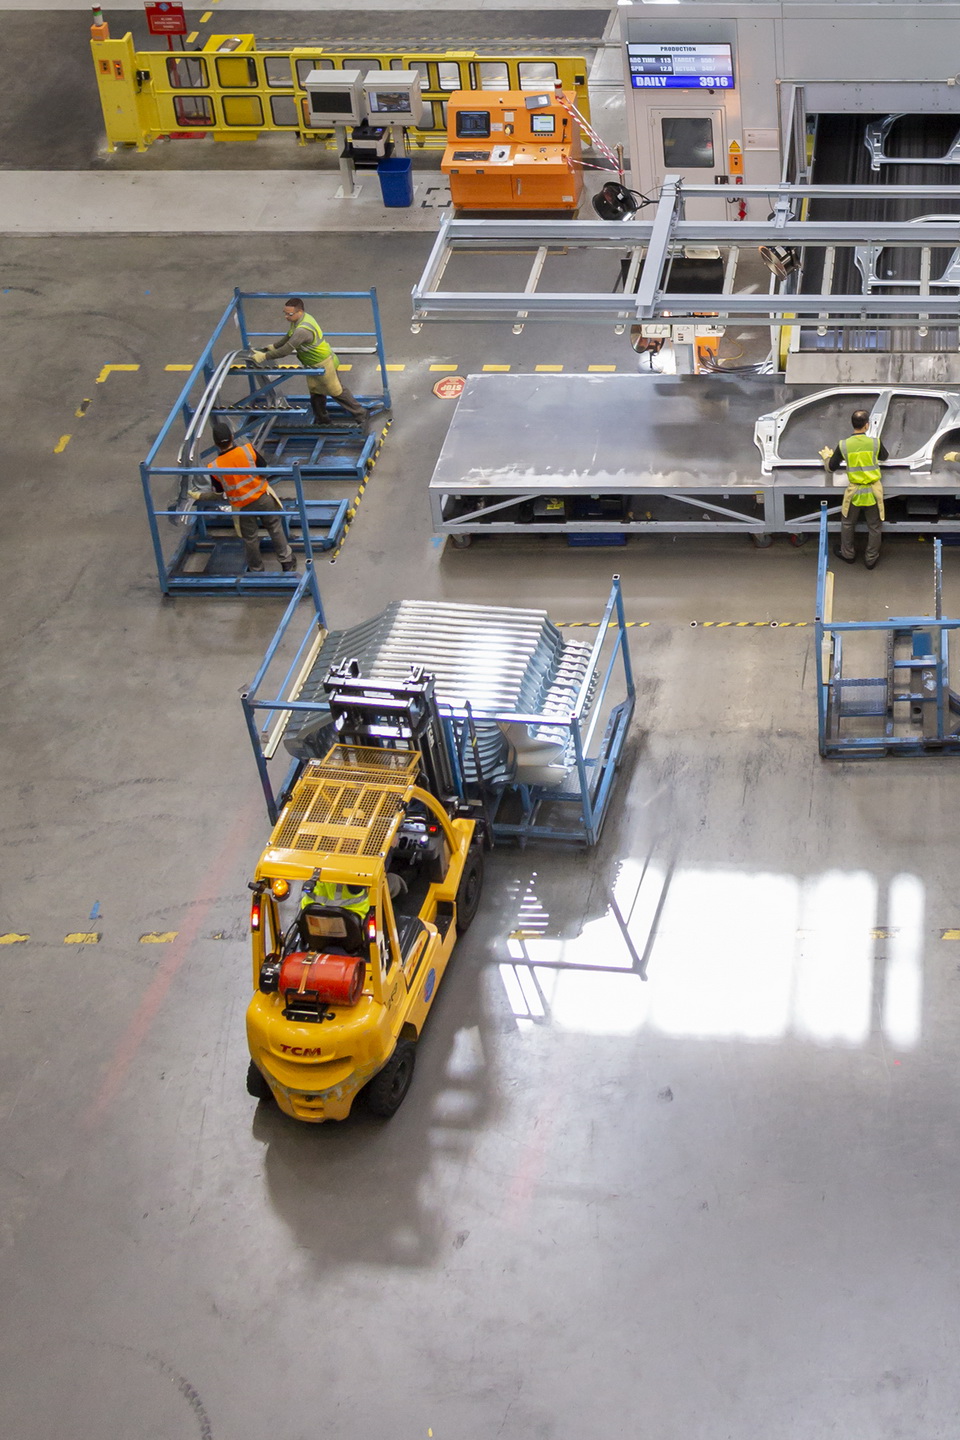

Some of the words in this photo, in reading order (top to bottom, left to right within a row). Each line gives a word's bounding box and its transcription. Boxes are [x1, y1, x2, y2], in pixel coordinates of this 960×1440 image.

[636, 76, 667, 87] DAILY
[699, 76, 729, 87] 3916
[279, 1043, 322, 1057] TCM
